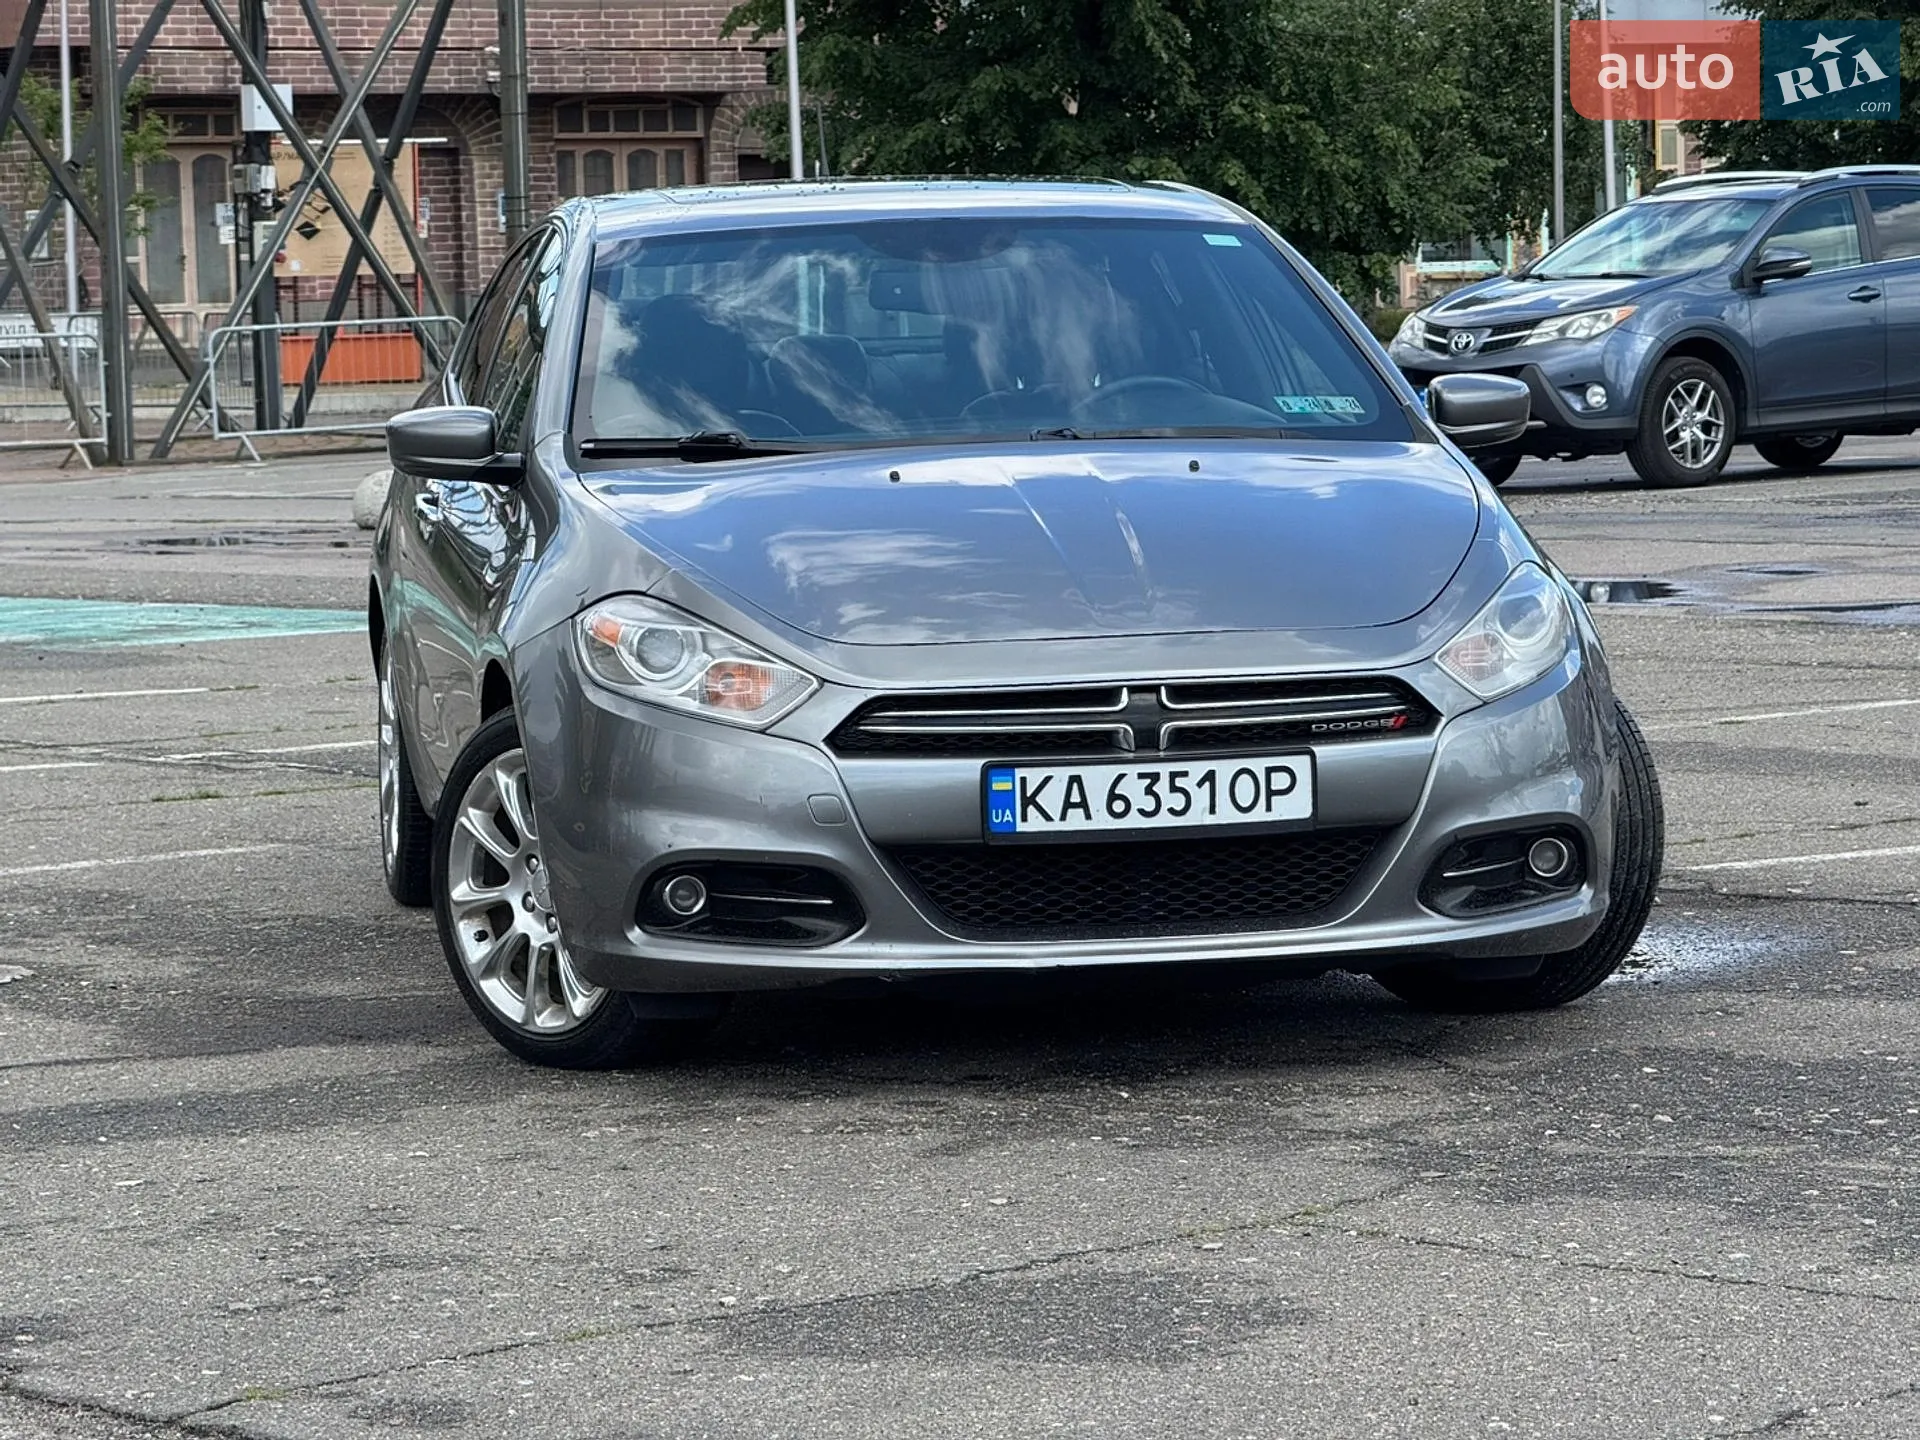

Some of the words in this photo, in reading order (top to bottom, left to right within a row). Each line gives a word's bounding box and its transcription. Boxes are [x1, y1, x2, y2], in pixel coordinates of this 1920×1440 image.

[1311, 718, 1395, 732] DODGE
[1019, 774, 1094, 822] KA
[1106, 769, 1217, 819] 6351
[992, 809, 1013, 823] UA
